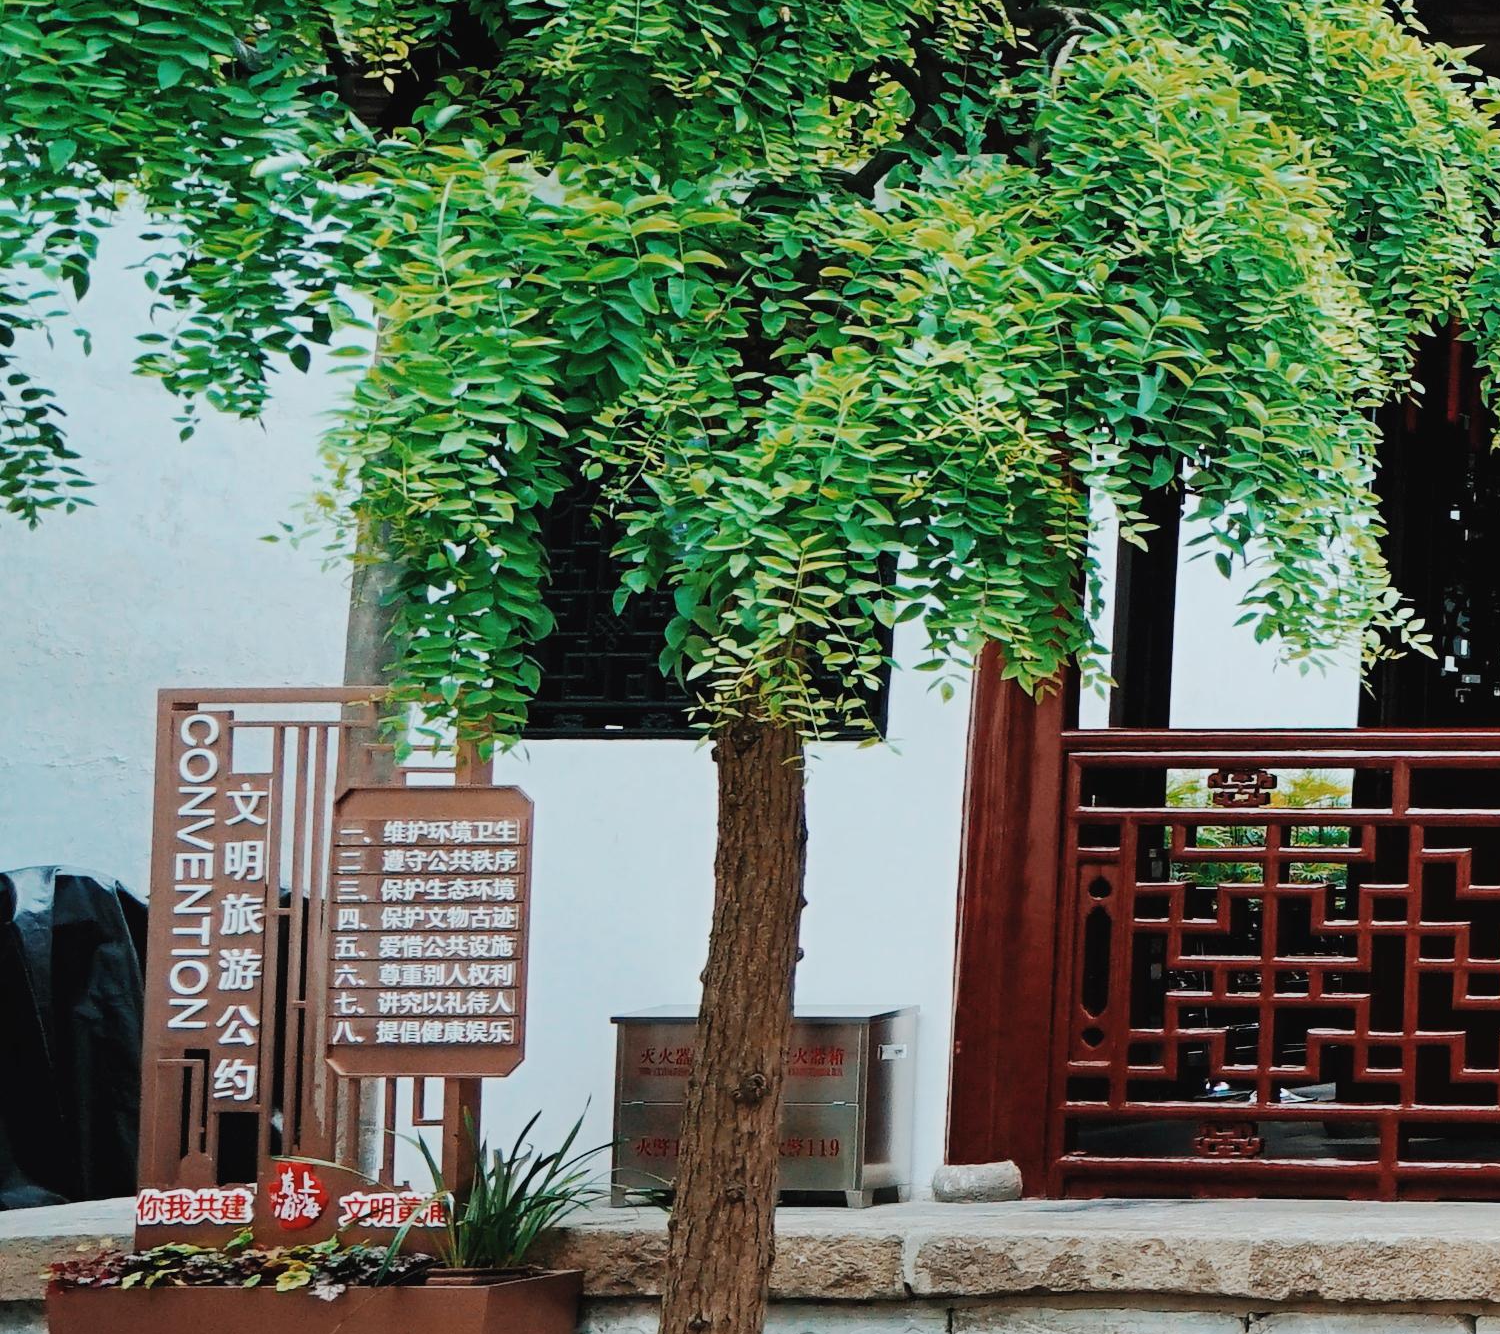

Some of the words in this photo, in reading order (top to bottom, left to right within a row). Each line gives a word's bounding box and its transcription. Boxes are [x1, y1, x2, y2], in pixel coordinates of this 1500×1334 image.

[167, 714, 219, 1030] CONVENTION
[212, 782, 268, 1101] 文明旅游公约
[136, 1190, 249, 1223] 你我共建
